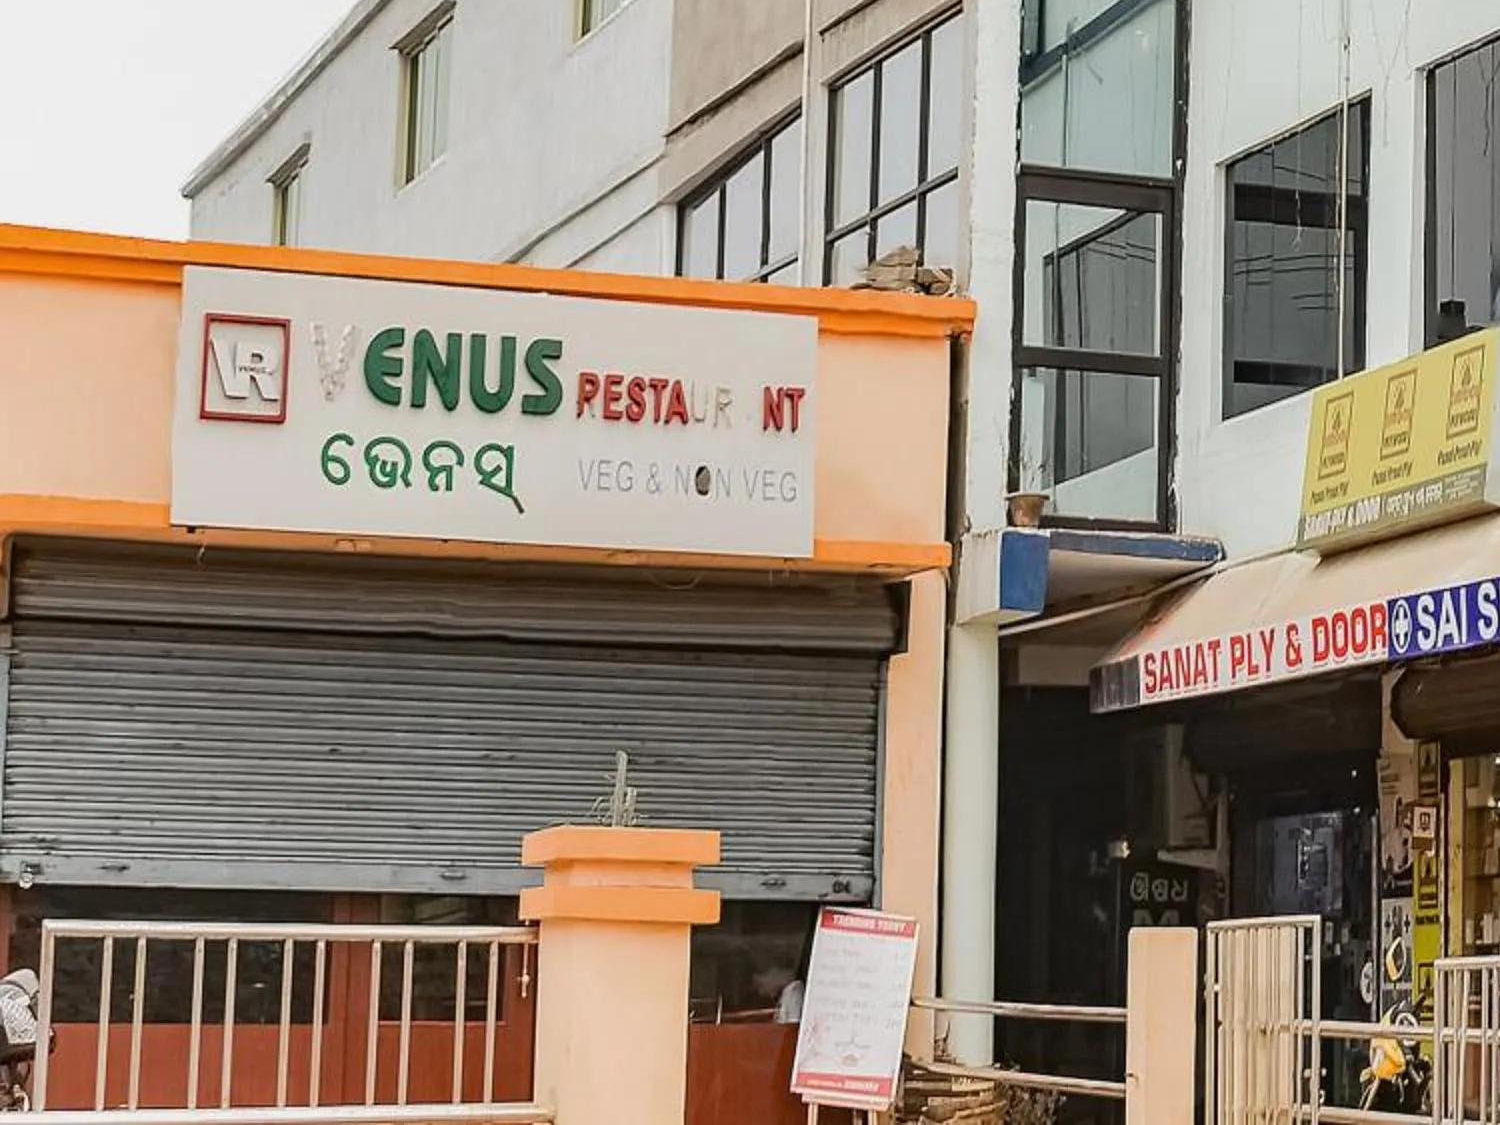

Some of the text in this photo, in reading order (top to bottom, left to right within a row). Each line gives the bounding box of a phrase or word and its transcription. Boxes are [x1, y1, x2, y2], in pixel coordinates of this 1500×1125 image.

[310, 321, 563, 416] VENUS
[578, 458, 798, 503] VEG & NON VEG
[1143, 638, 1222, 695] SANAT
[1230, 628, 1276, 681] PLY
[1284, 623, 1303, 668] &
[1312, 605, 1388, 662] DOOR
[1415, 591, 1468, 651] SAI
